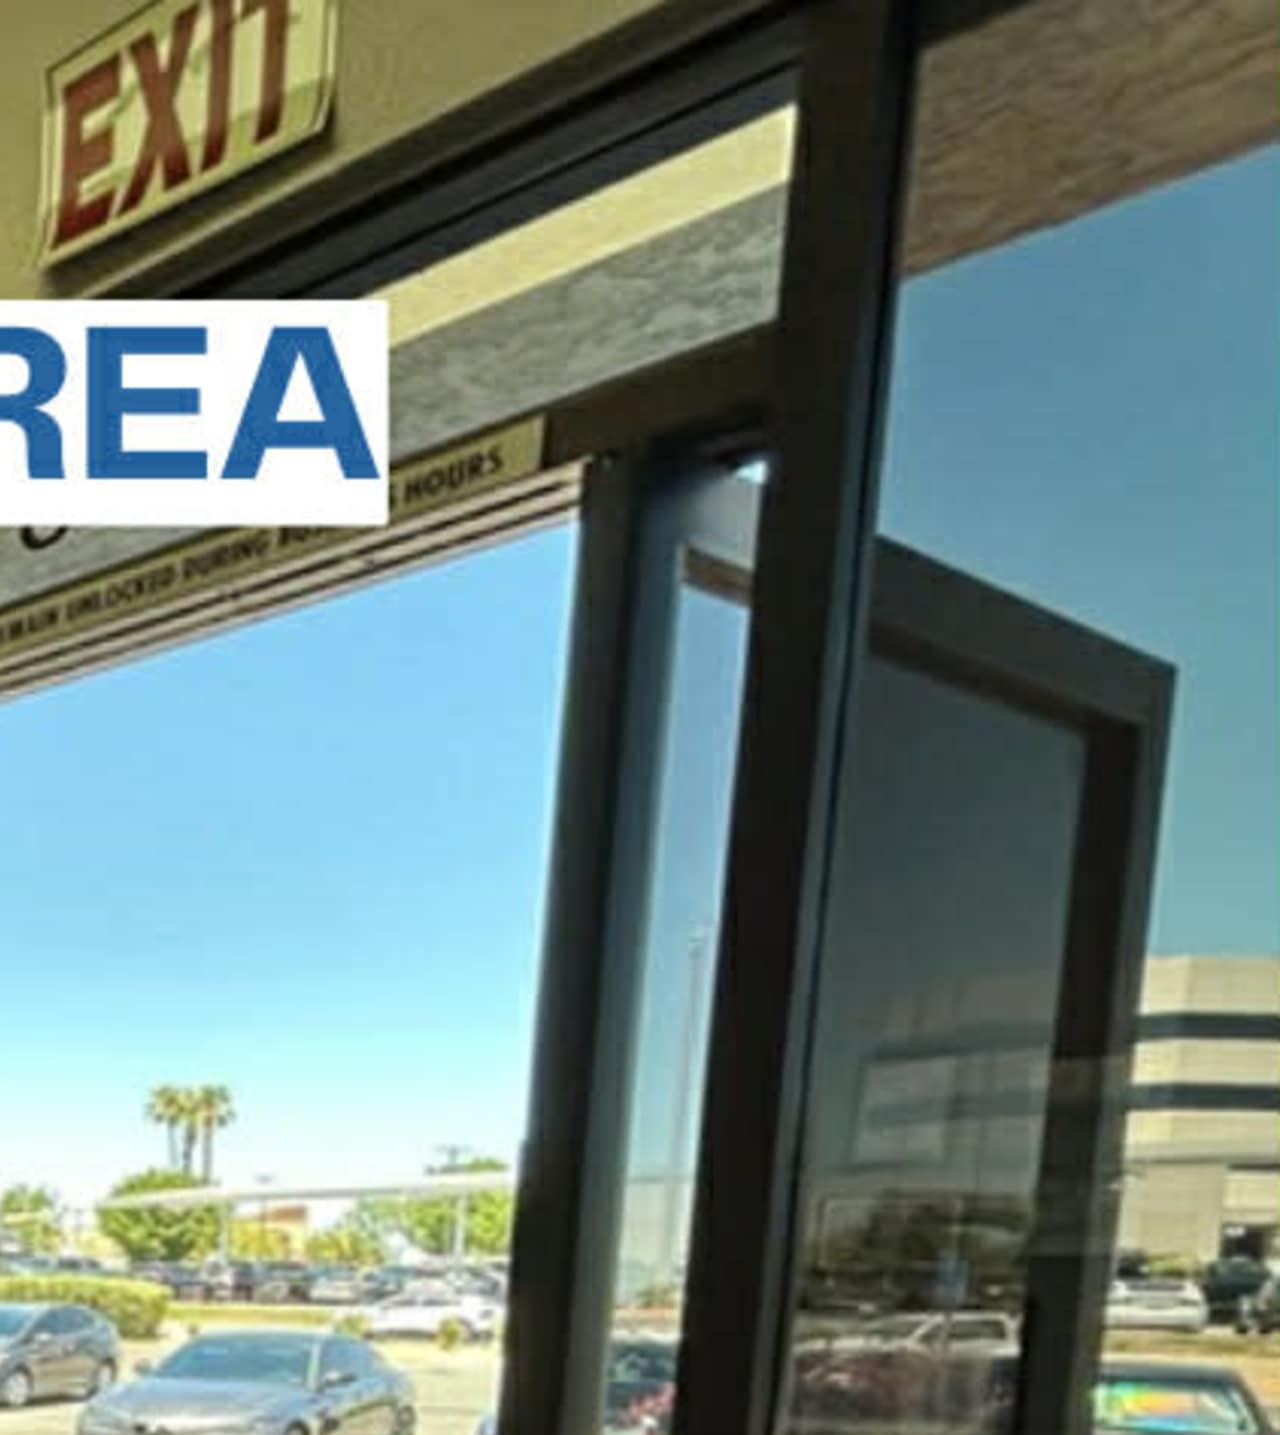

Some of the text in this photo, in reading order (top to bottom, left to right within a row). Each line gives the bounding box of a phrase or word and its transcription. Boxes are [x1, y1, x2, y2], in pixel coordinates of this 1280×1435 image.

[51, 0, 289, 250] EXIT
[66, 563, 177, 620] UNLOCKED
[181, 530, 272, 580] DURING
[403, 445, 506, 503] HOURS
